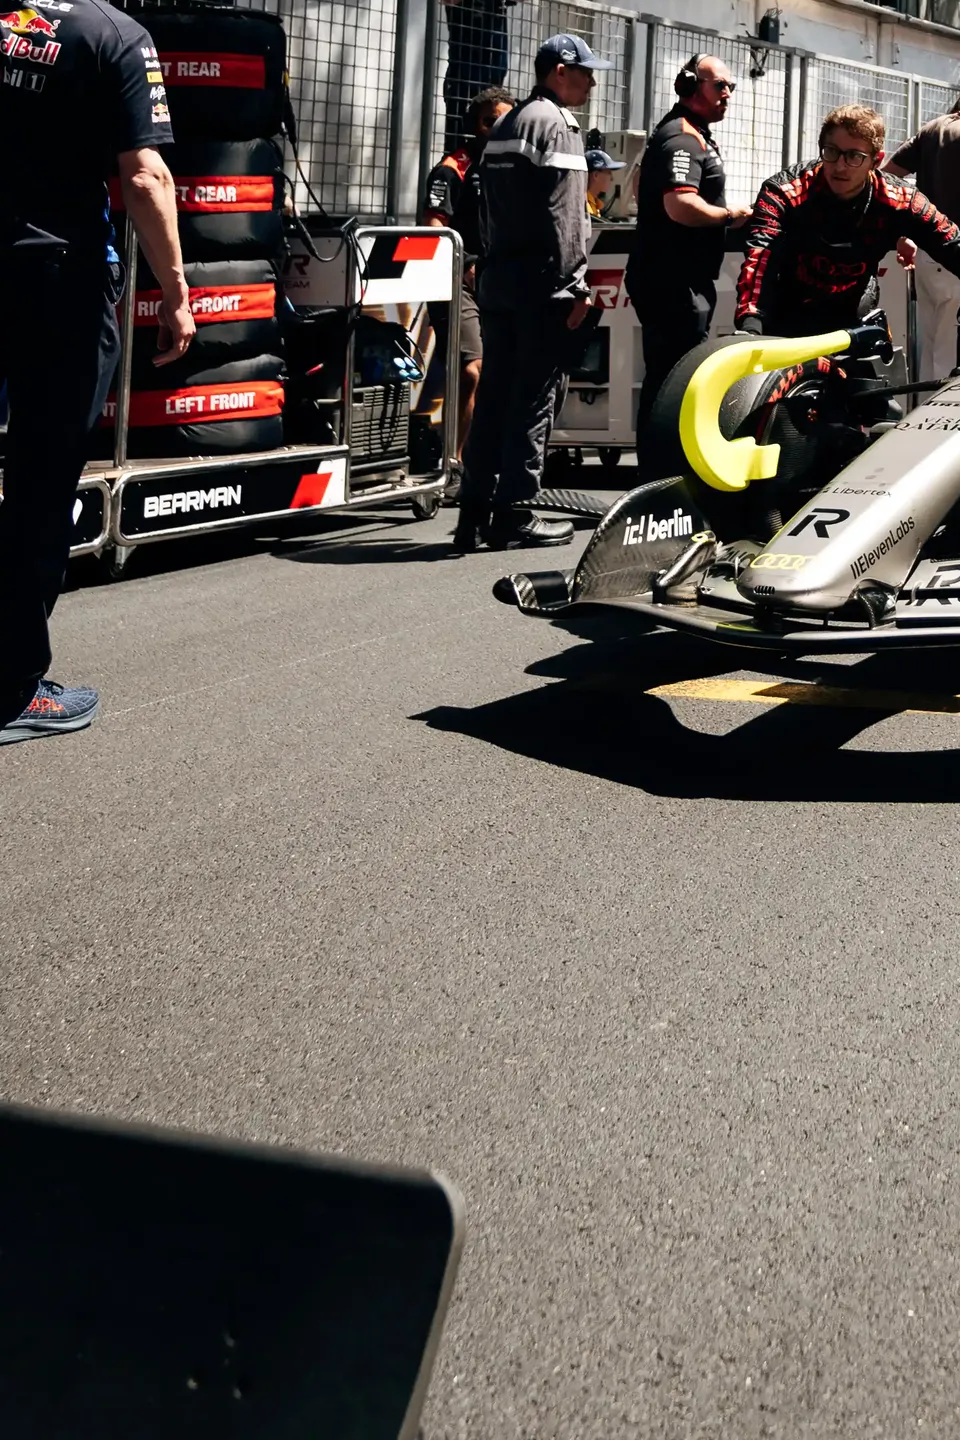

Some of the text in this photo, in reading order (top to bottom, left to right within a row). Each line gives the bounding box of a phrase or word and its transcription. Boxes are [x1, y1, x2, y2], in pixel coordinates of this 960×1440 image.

[177, 61, 221, 78] REAR
[194, 185, 237, 202] REAR
[192, 295, 242, 314] FRONT
[165, 392, 256, 415] LEFT FRONT
[143, 484, 242, 519] BEARMAN
[832, 487, 892, 498] Libertex
[646, 508, 693, 542] berlin
